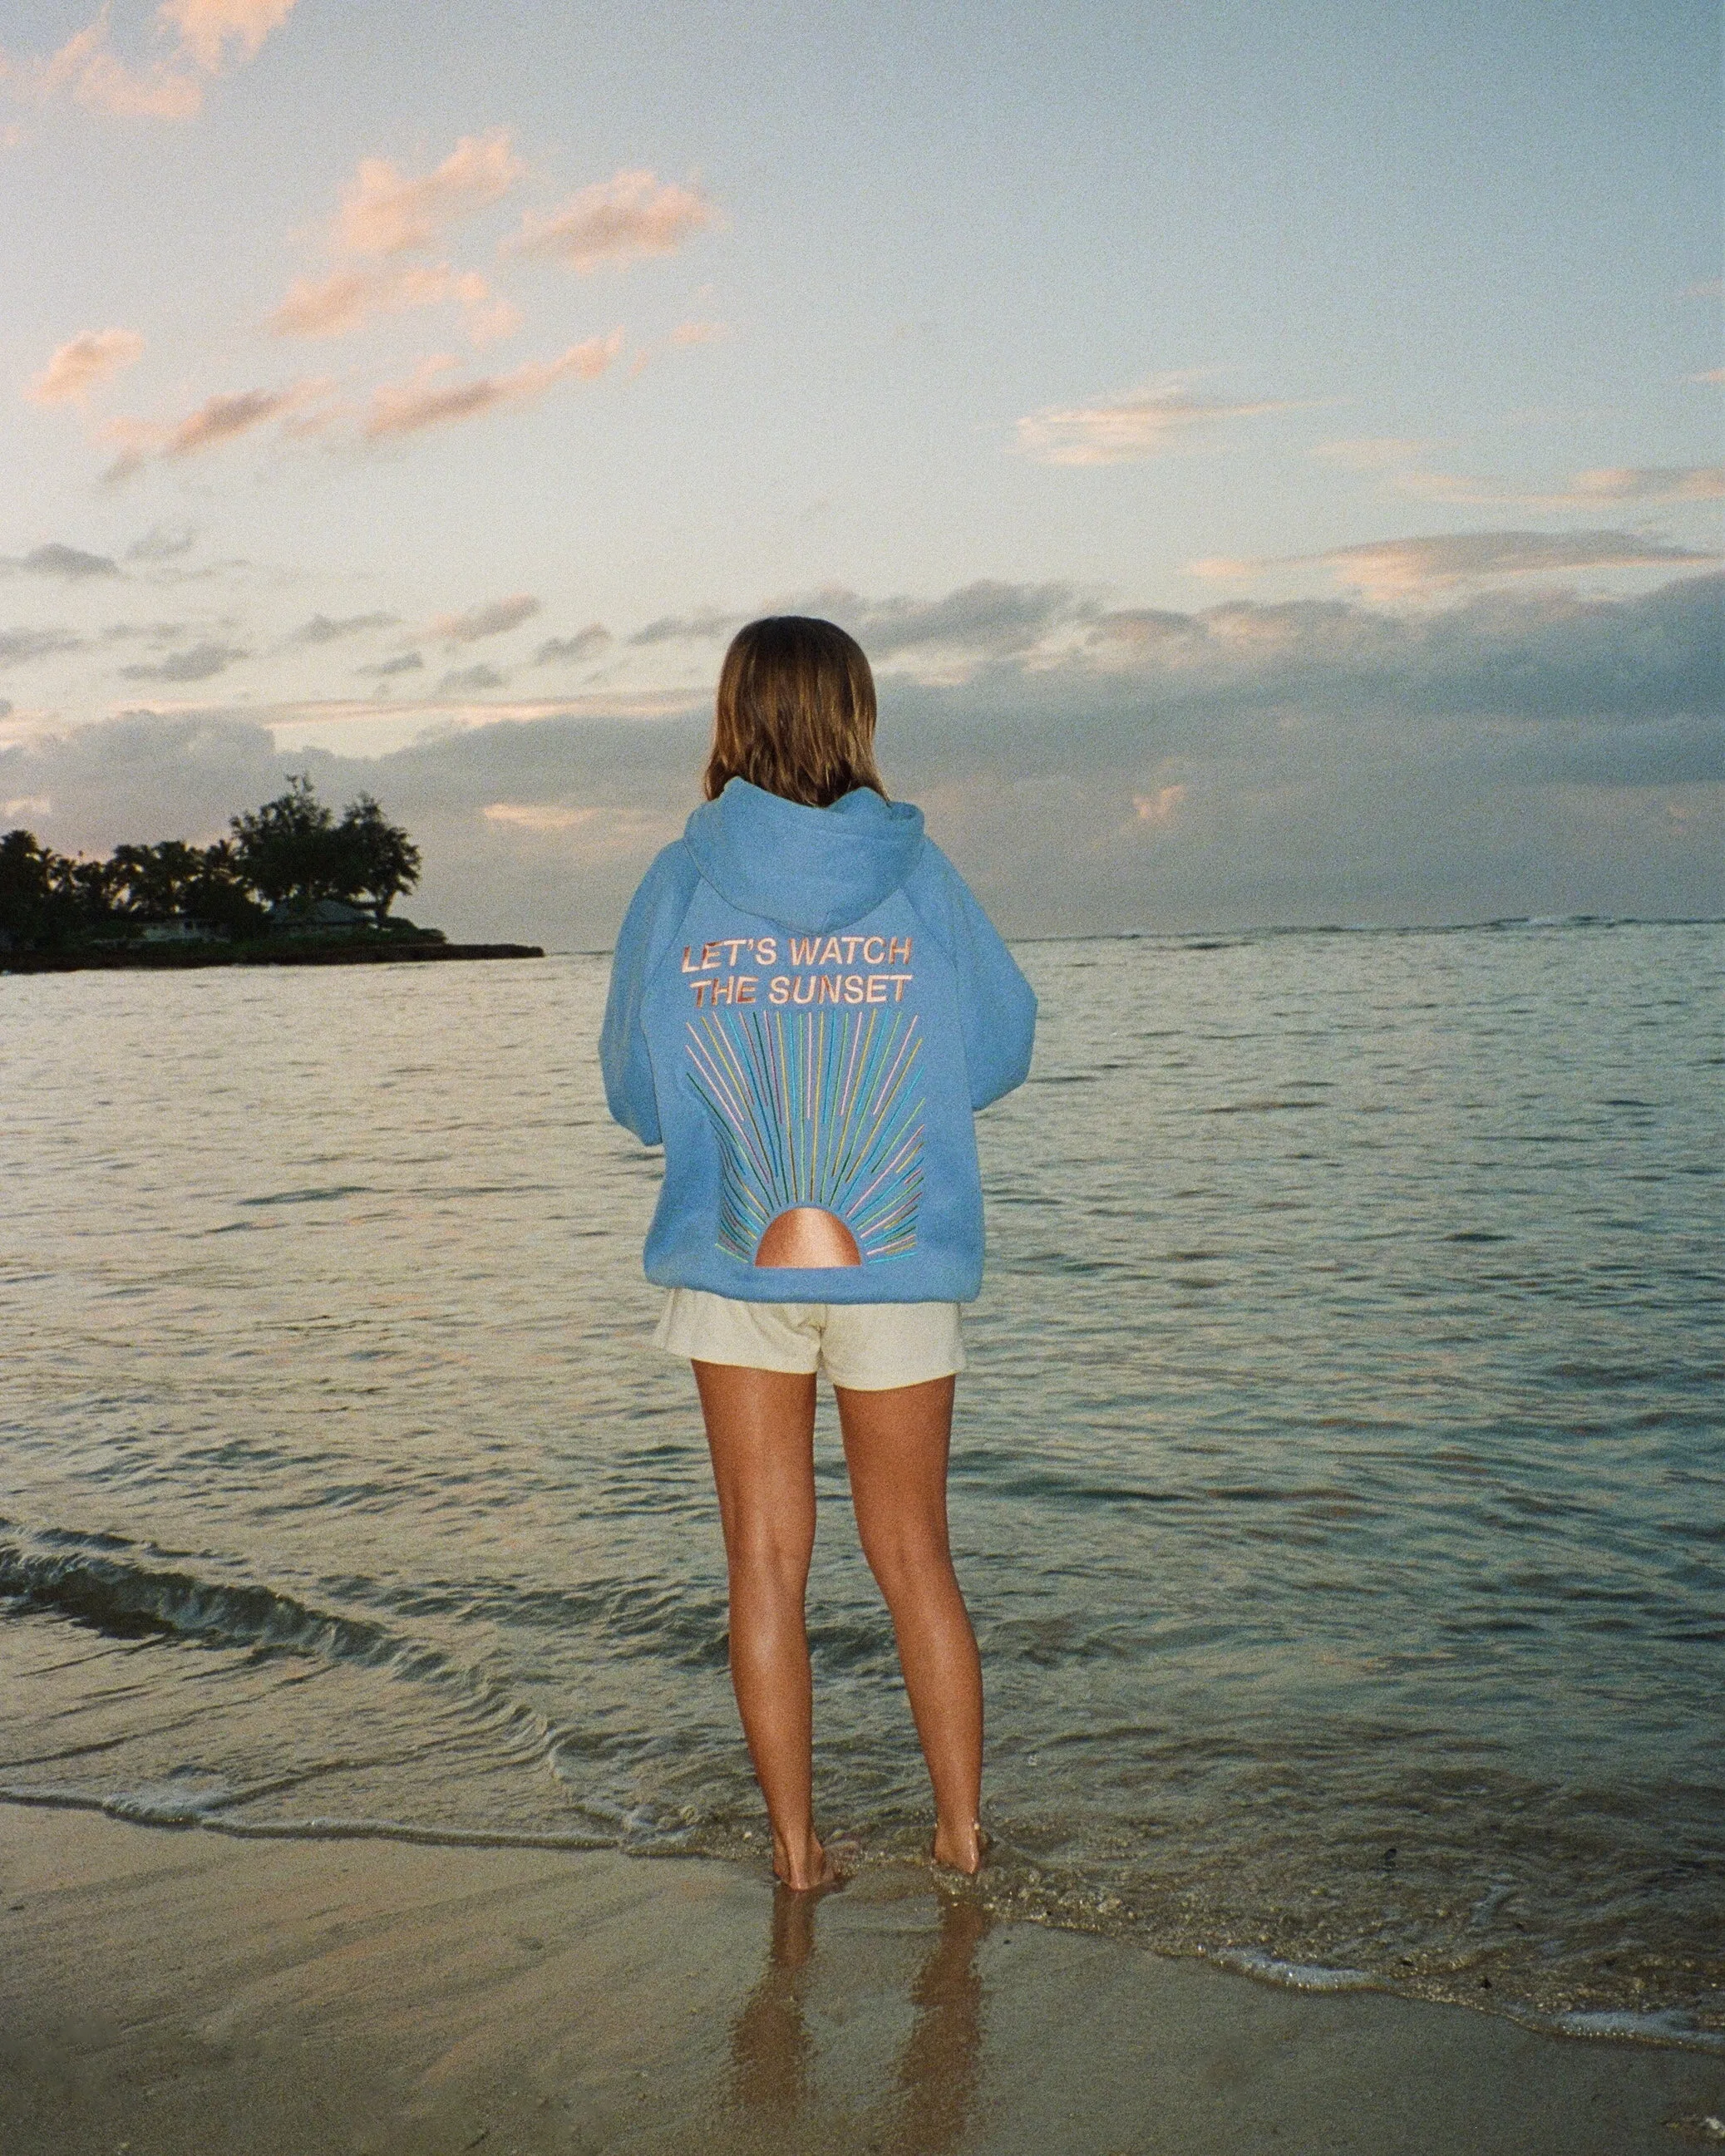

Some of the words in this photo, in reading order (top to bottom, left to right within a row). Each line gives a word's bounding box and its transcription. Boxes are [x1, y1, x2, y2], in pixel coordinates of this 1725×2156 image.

[681, 937, 777, 973] LET'S
[789, 936, 914, 967] WATCH
[689, 975, 759, 1008] THE
[768, 974, 914, 1004] SUNSET
